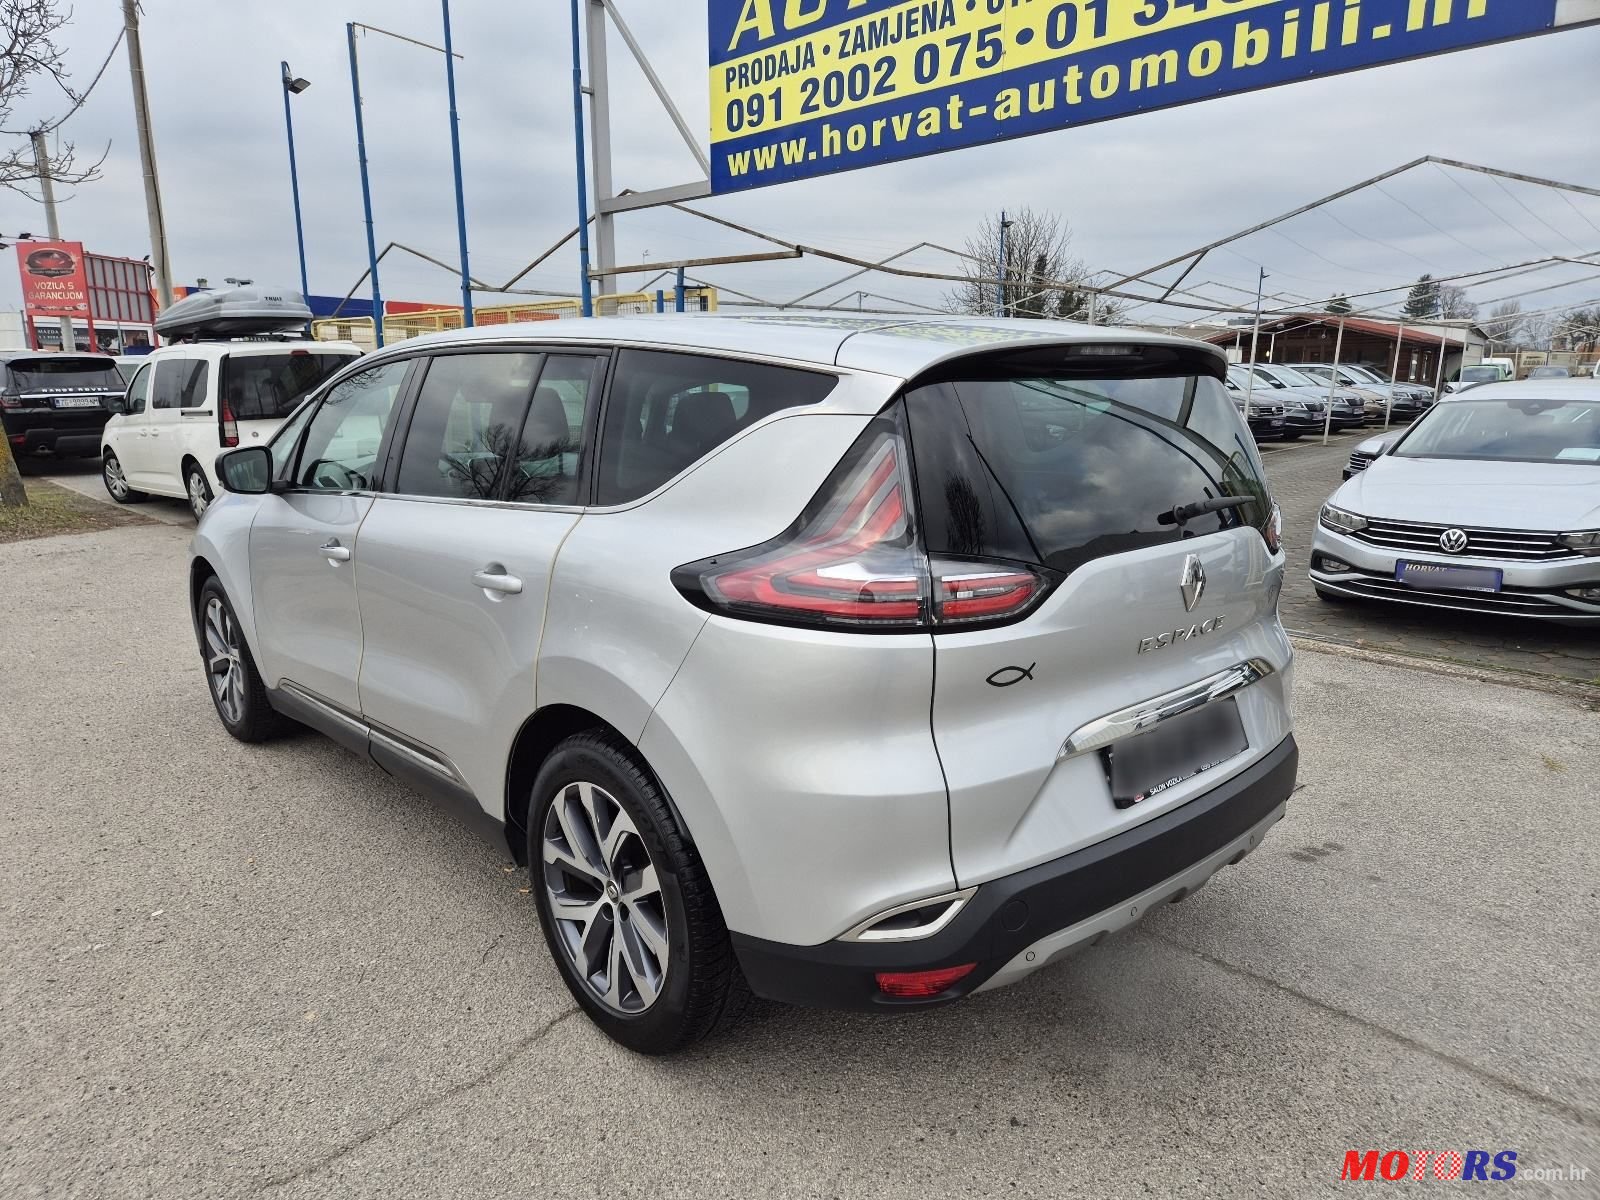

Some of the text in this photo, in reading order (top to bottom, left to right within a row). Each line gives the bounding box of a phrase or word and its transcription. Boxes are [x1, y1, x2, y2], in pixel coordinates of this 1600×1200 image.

[725, 0, 956, 93] PRODAJA ZAMJENA
[726, 87, 783, 133] 091
[799, 55, 897, 115] 2002
[914, 24, 1003, 85] 075
[1045, 0, 1108, 50] 01
[28, 291, 84, 300] GARANCIJOM
[34, 281, 75, 290] VOZILA S
[1404, 563, 1448, 573] HORVAT
[1137, 614, 1226, 655] ESPACE
